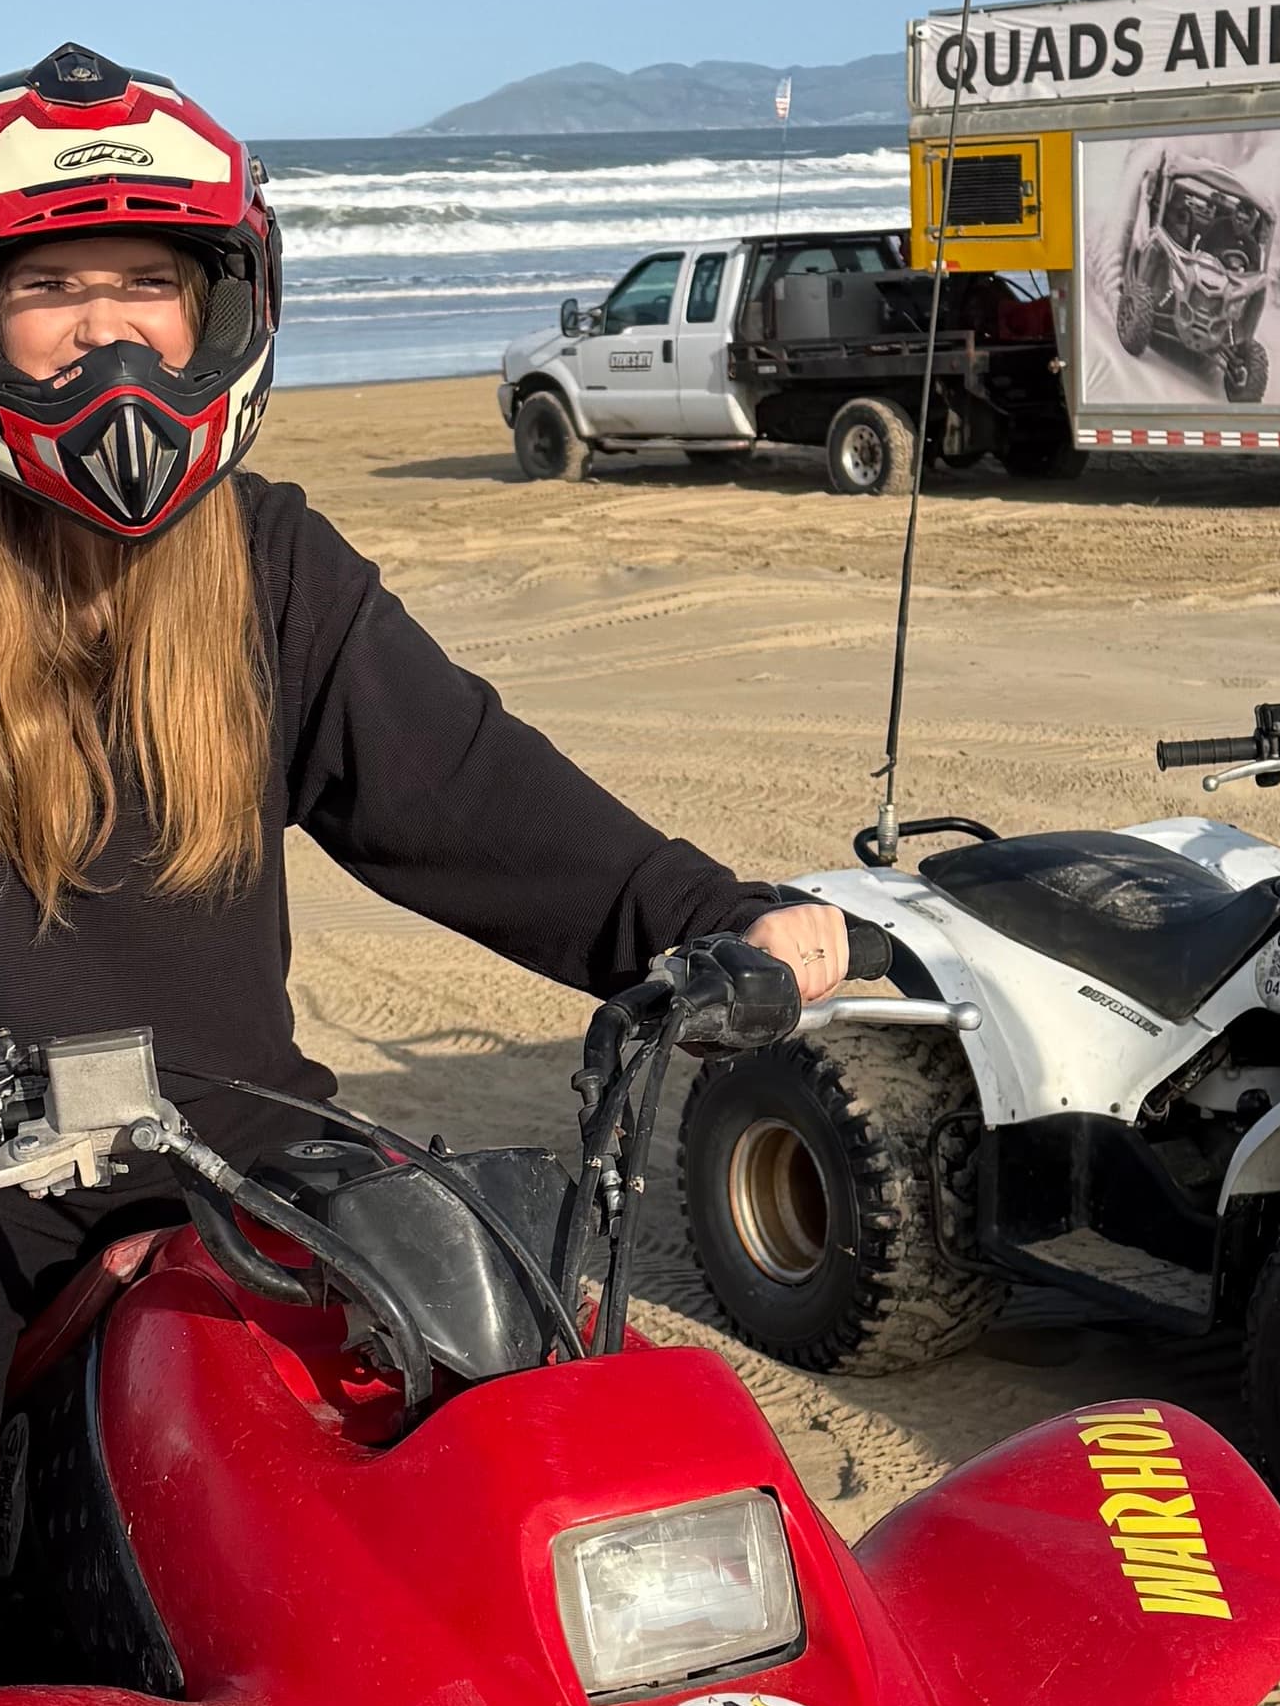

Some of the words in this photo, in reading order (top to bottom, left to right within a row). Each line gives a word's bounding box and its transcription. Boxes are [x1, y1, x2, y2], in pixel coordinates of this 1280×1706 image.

[936, 17, 1144, 94] QUADS
[1078, 985, 1163, 1037] AUTOMATIC
[1076, 1408, 1233, 1620] WARHOL
